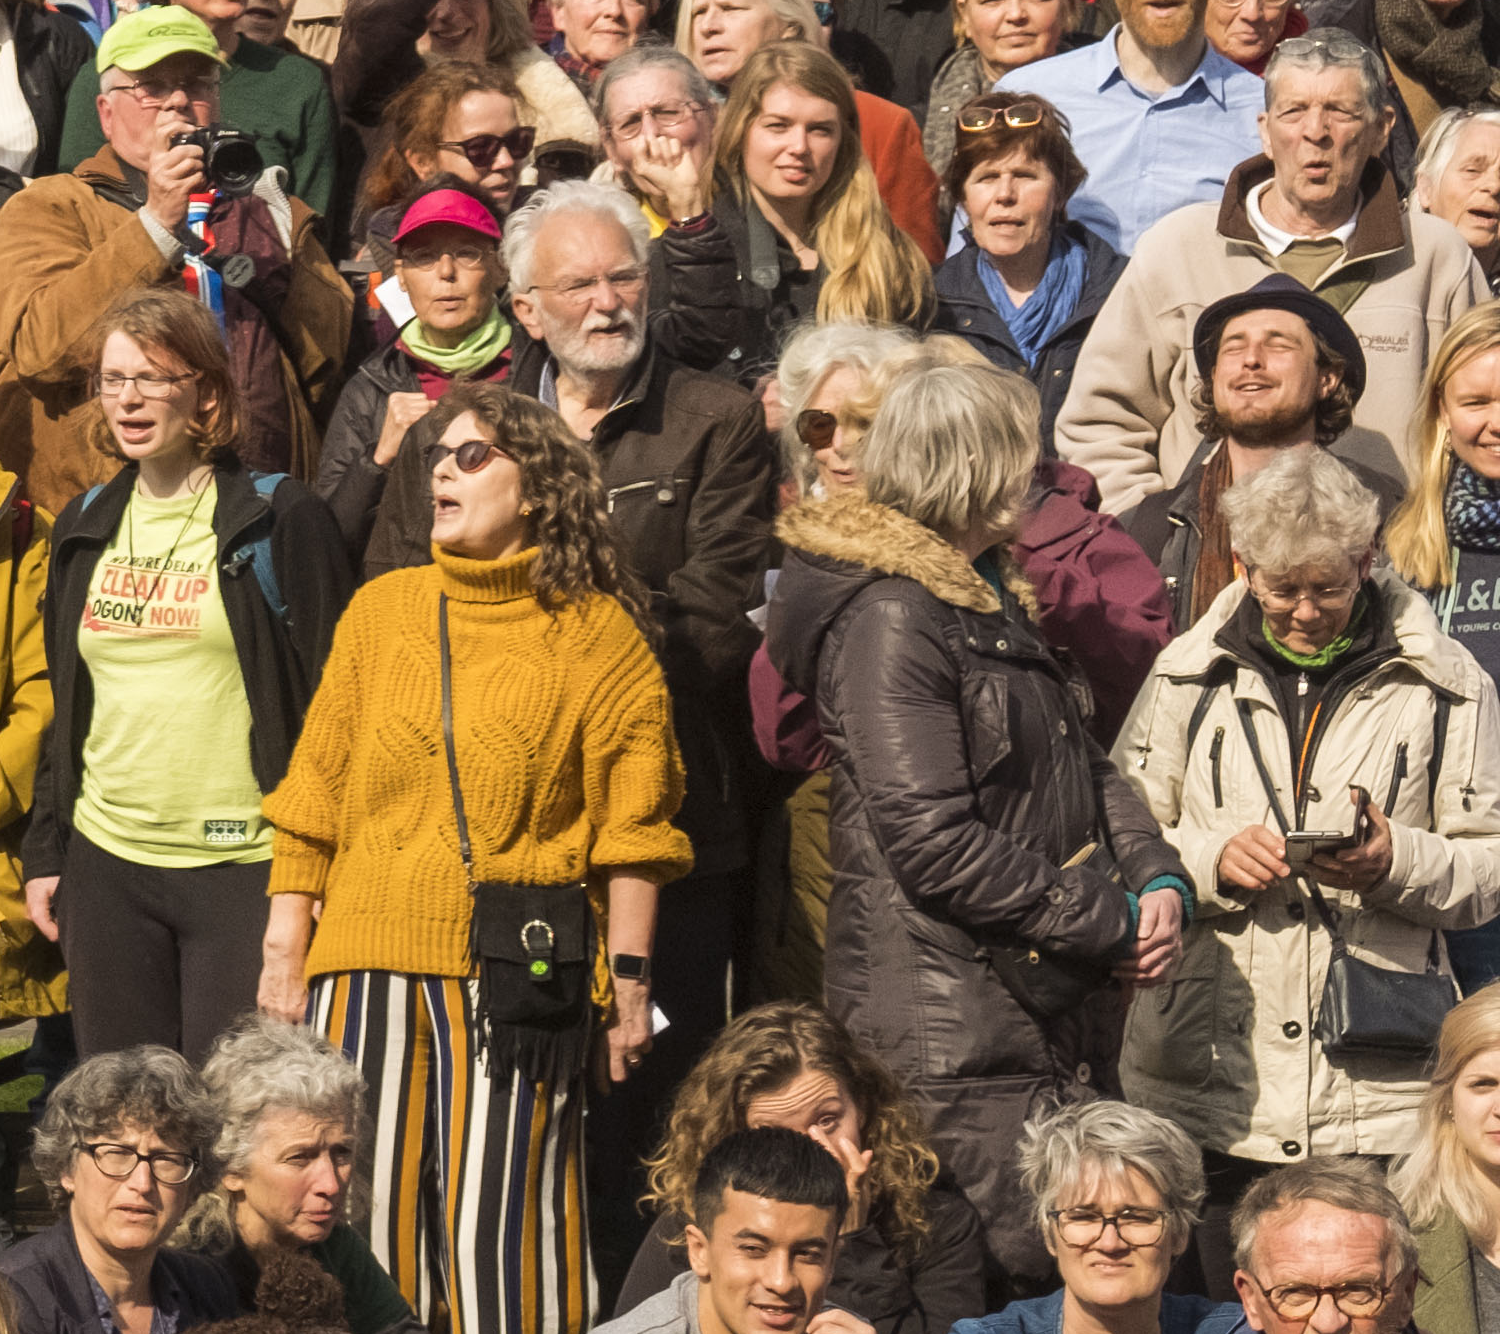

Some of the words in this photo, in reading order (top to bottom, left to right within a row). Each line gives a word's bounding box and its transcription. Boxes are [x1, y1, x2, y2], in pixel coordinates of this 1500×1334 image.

[163, 559, 202, 574] DELAY
[100, 569, 168, 602] CLEAN
[174, 578, 209, 603] UP
[150, 607, 200, 627] NOW!
